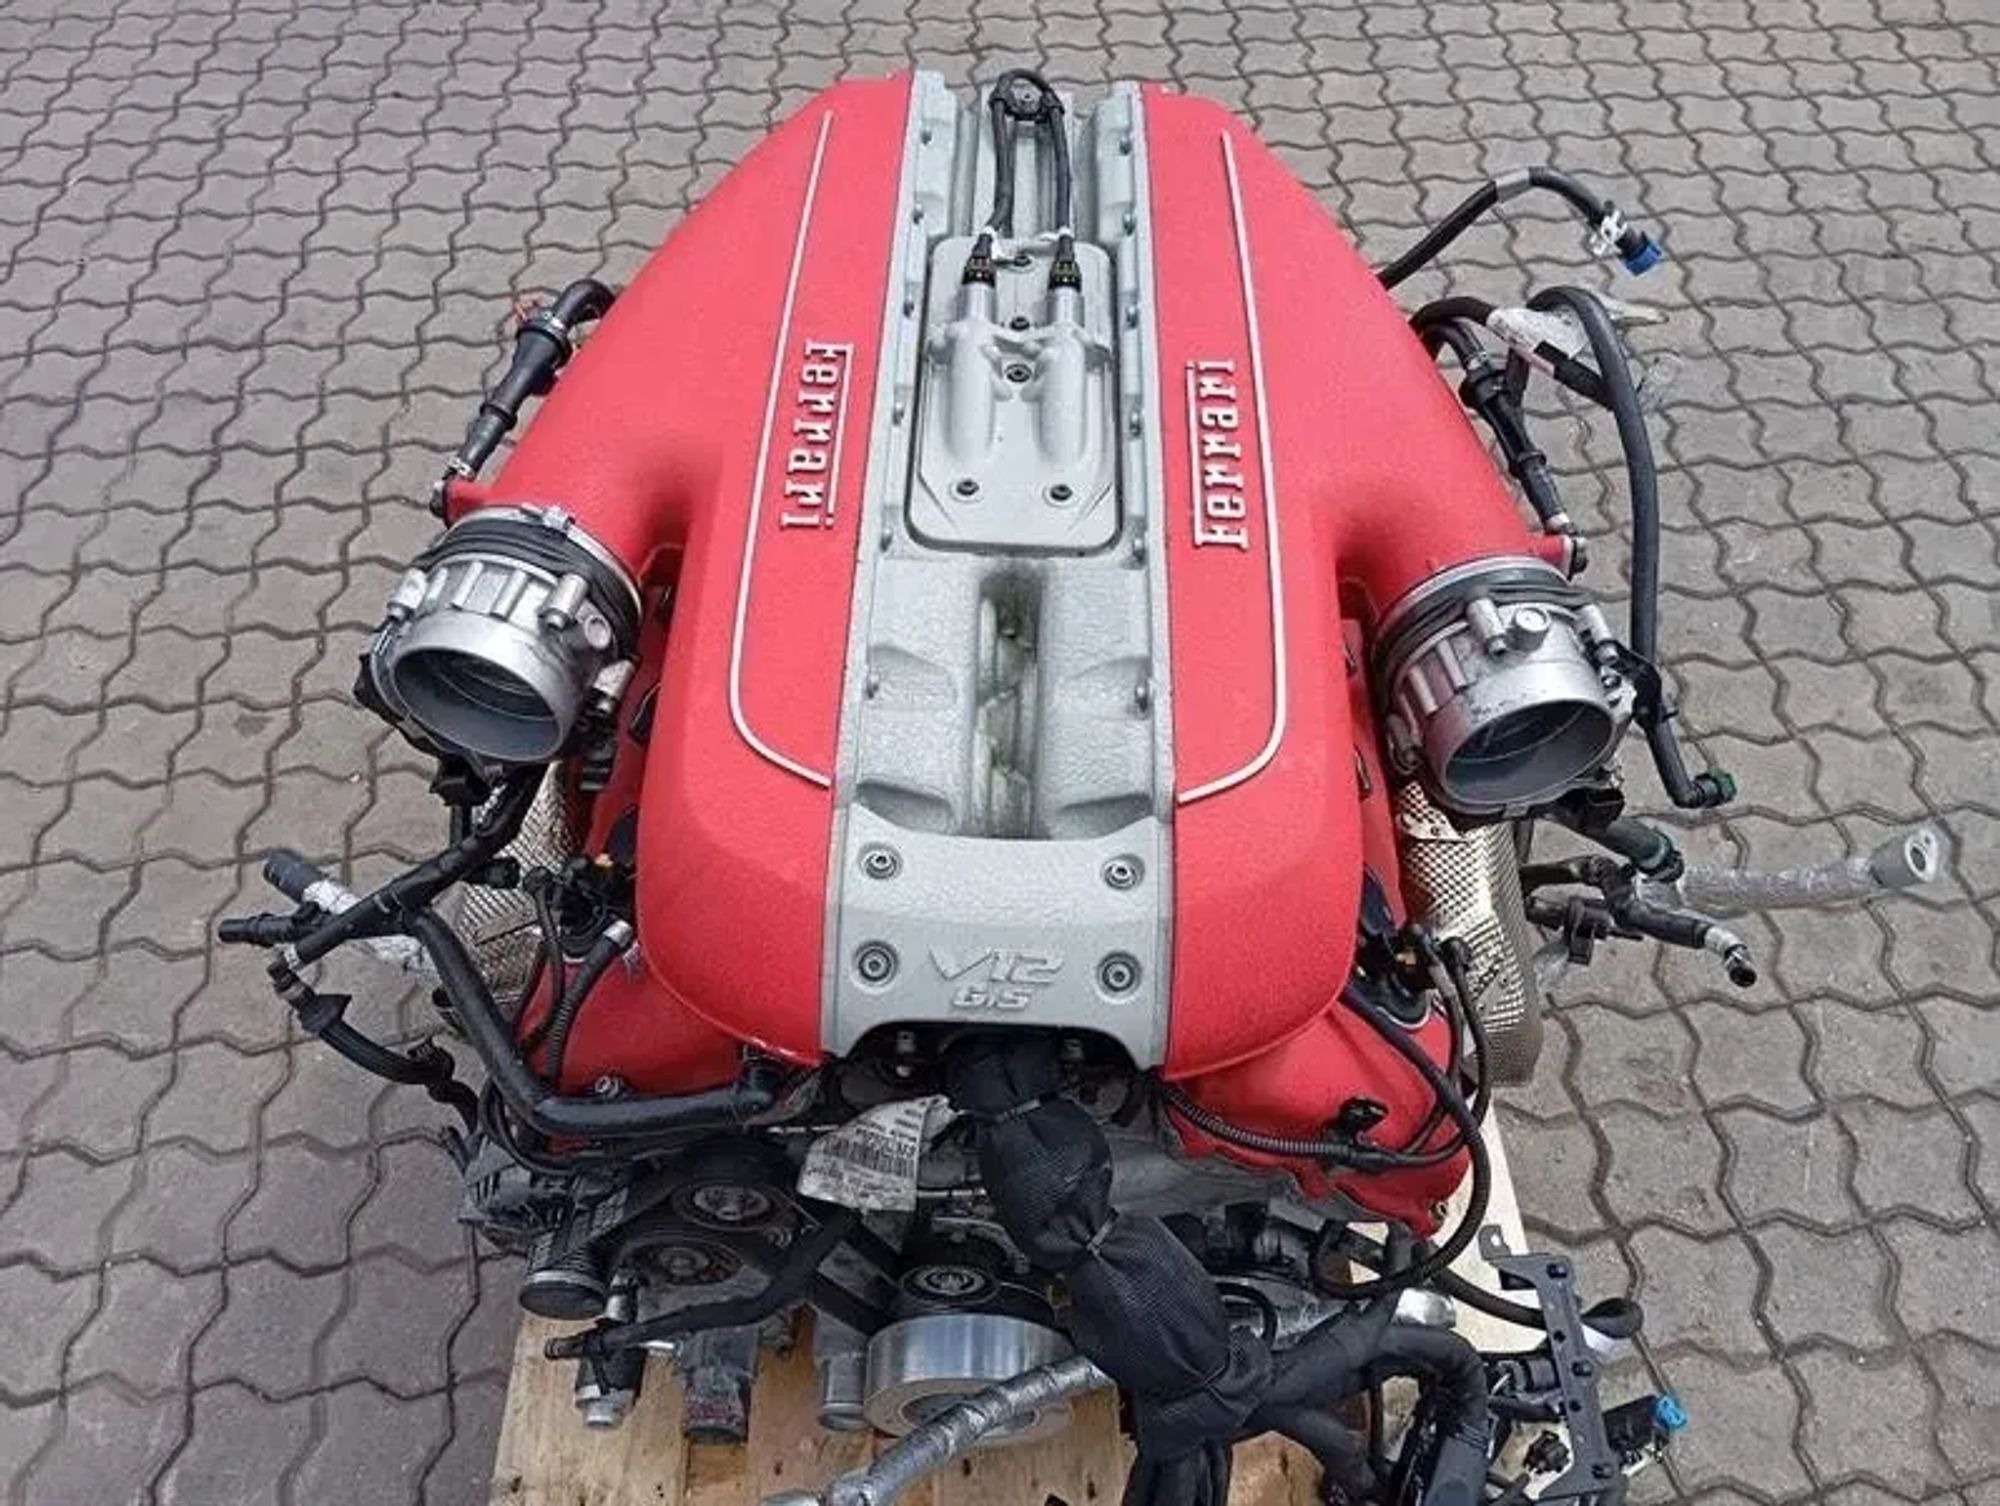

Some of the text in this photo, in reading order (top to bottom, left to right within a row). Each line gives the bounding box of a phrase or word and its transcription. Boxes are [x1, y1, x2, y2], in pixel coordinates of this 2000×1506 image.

[780, 340, 854, 529] Ferrari
[1185, 360, 1249, 550] Ferrari
[928, 945, 1063, 984] V12
